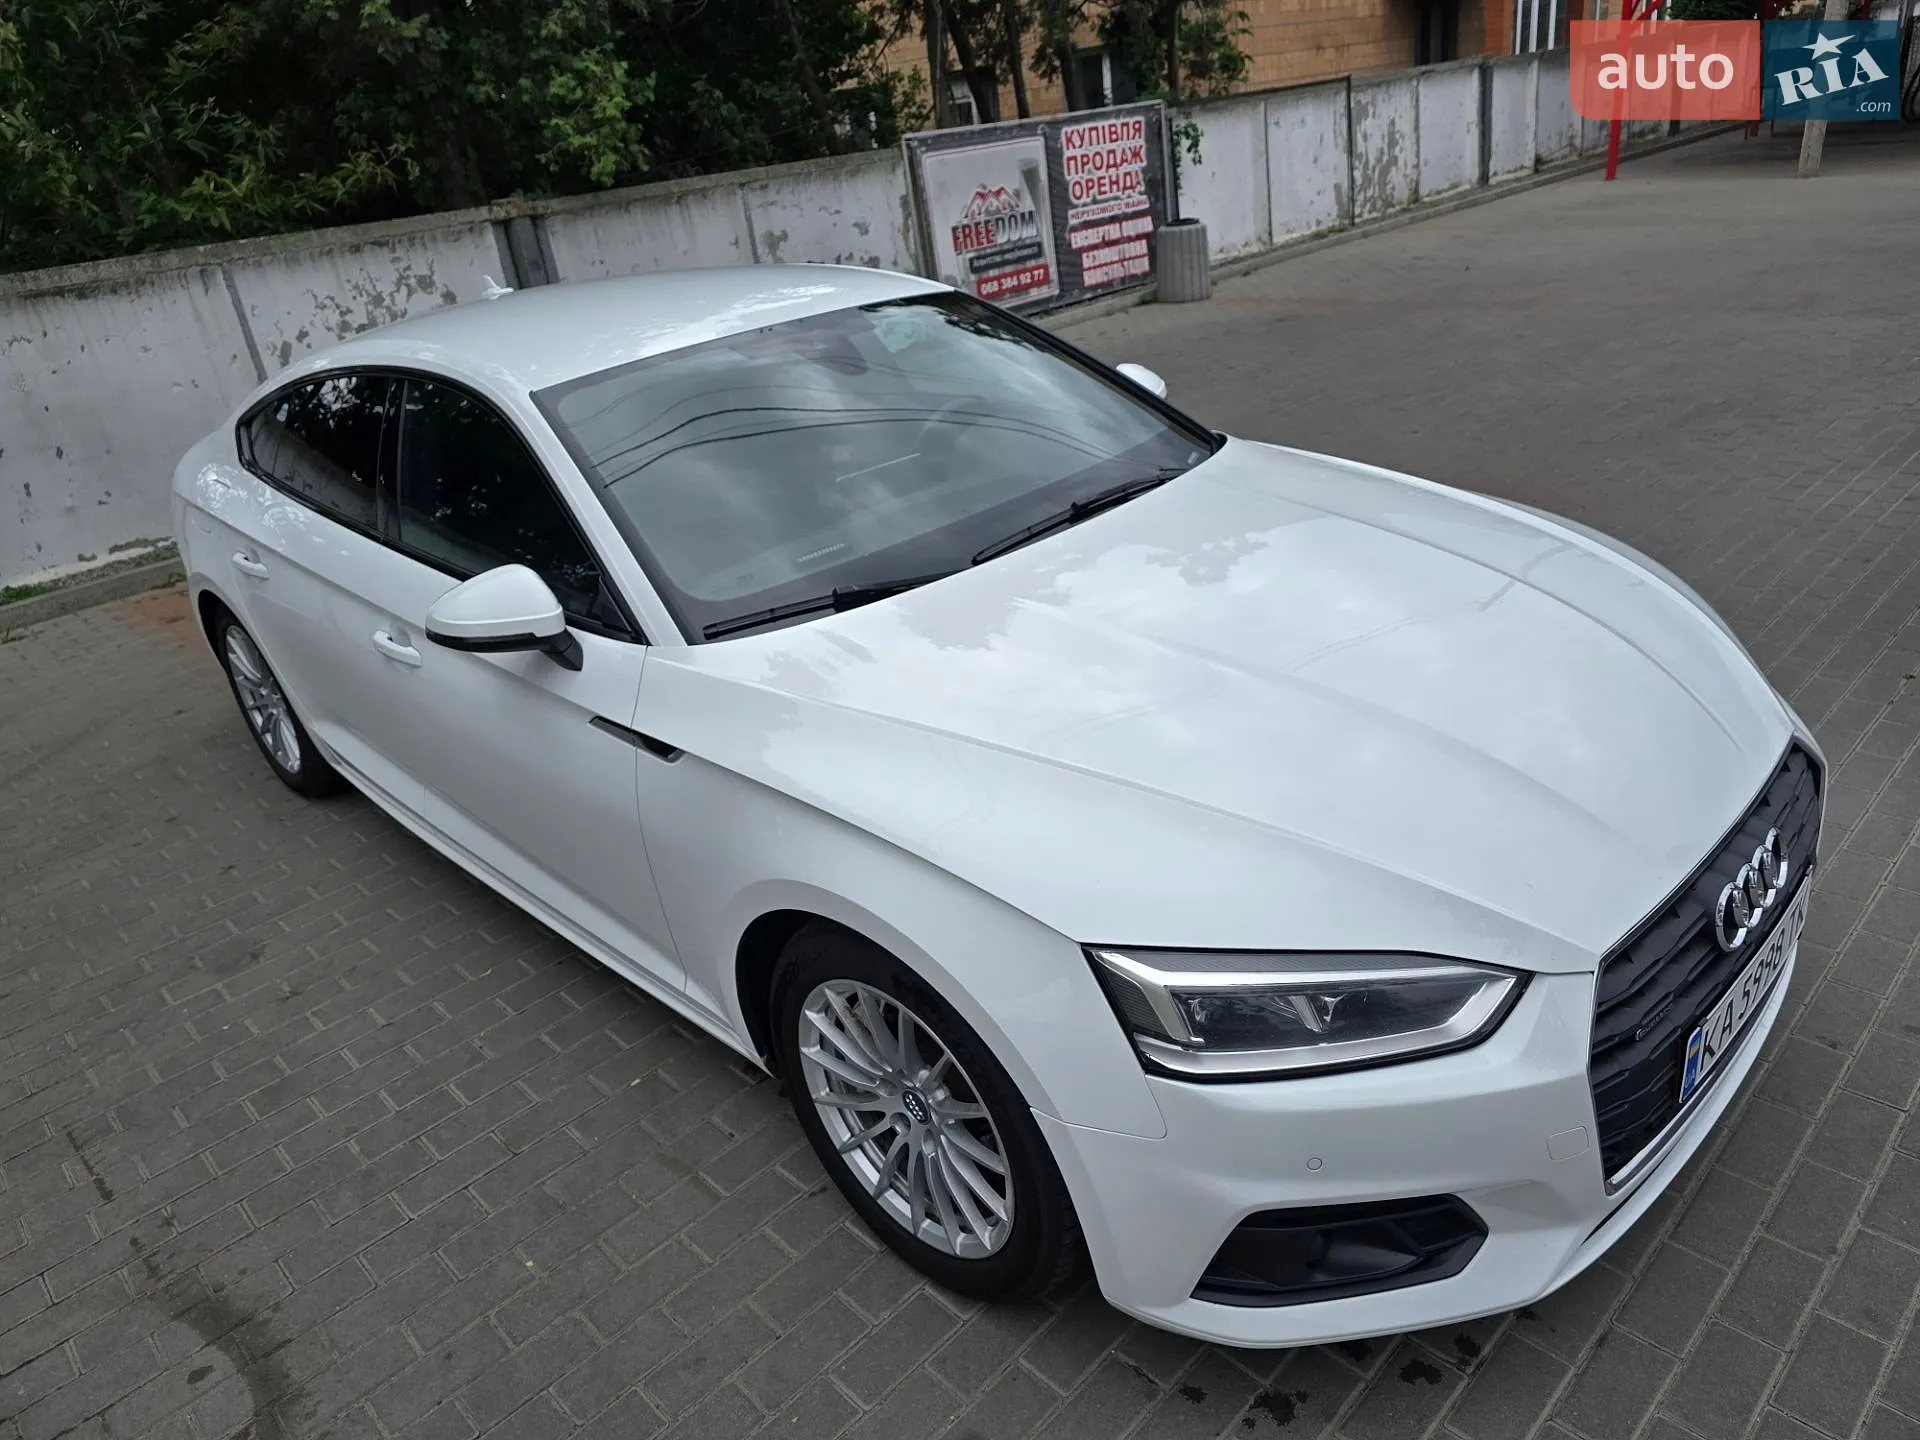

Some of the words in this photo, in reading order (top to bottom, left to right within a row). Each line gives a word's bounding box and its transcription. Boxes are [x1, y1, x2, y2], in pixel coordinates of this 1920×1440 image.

[1064, 120, 1142, 150] КУПІВЛЯ
[1066, 145, 1144, 176] ПРОДАЖ
[1072, 170, 1142, 200] ОРЕНДА
[951, 210, 1037, 253] FREEDOM
[1700, 998, 1734, 1073] KA
[1738, 927, 1785, 1020] 5998
